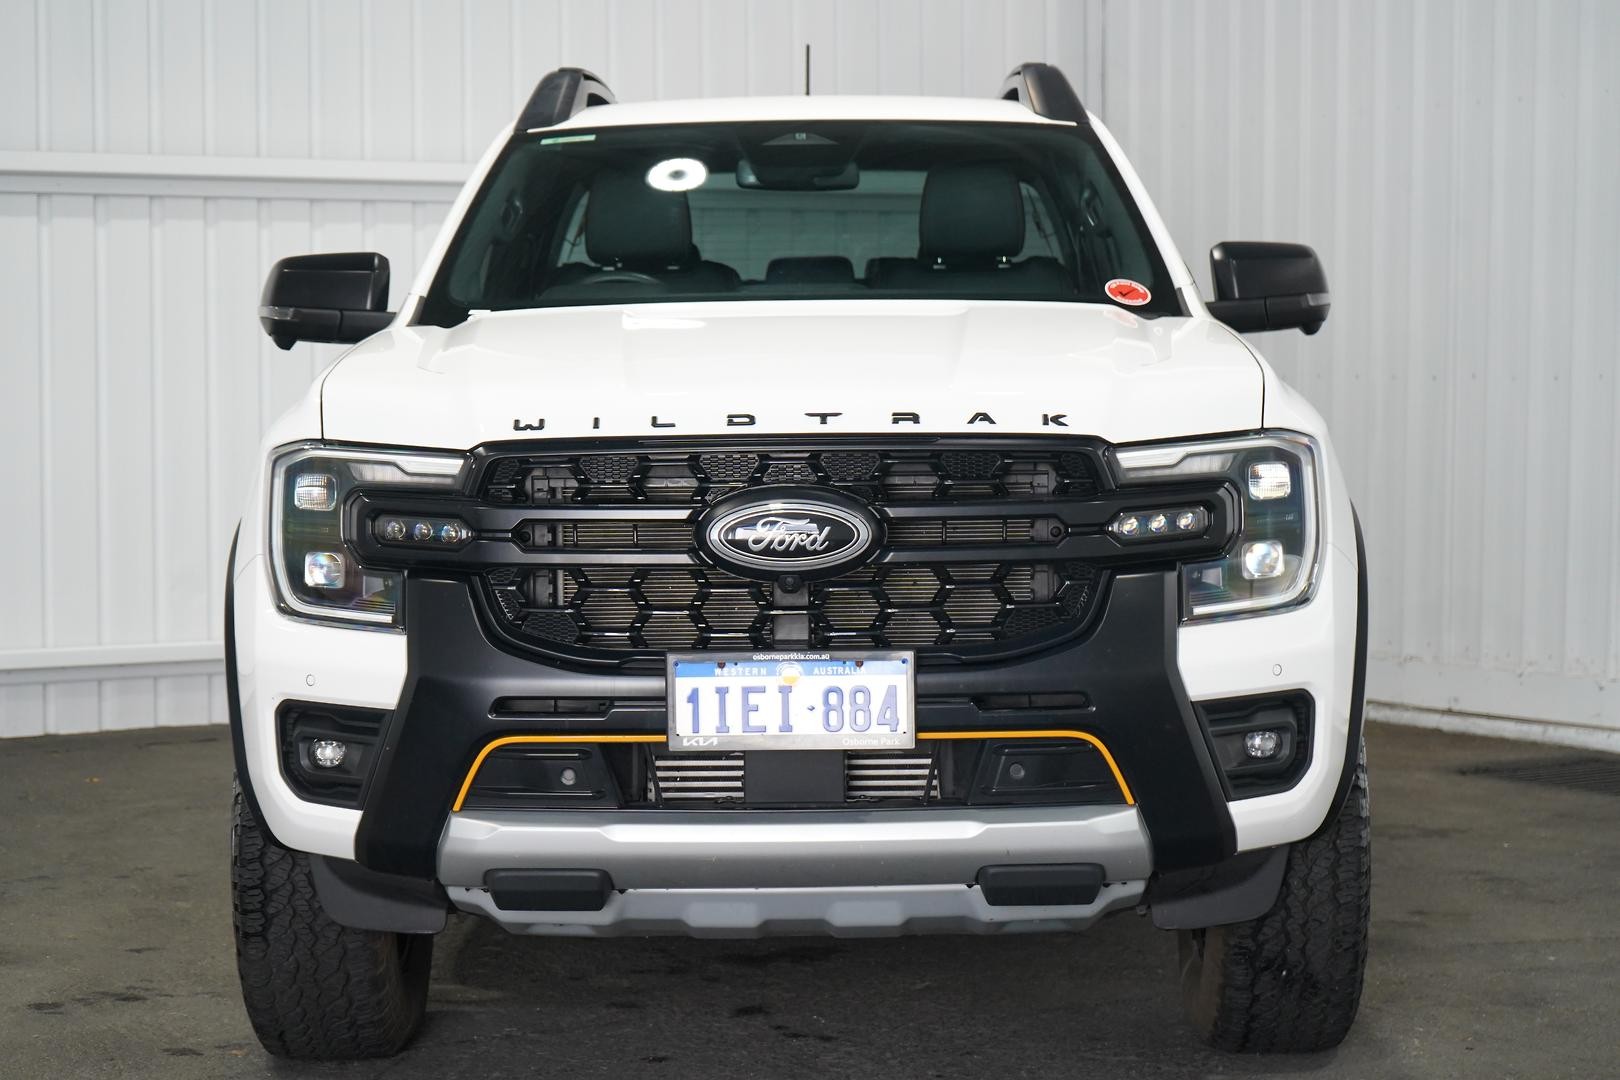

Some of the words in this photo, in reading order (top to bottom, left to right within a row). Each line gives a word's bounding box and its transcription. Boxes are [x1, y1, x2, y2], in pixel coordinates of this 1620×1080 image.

[513, 413, 1069, 431] WILDTRAK
[747, 516, 831, 552] Ford
[714, 668, 767, 676] WESTERN
[813, 666, 866, 676] AUSTRALIA
[842, 737, 878, 746] Osborne
[880, 737, 900, 746] Park
